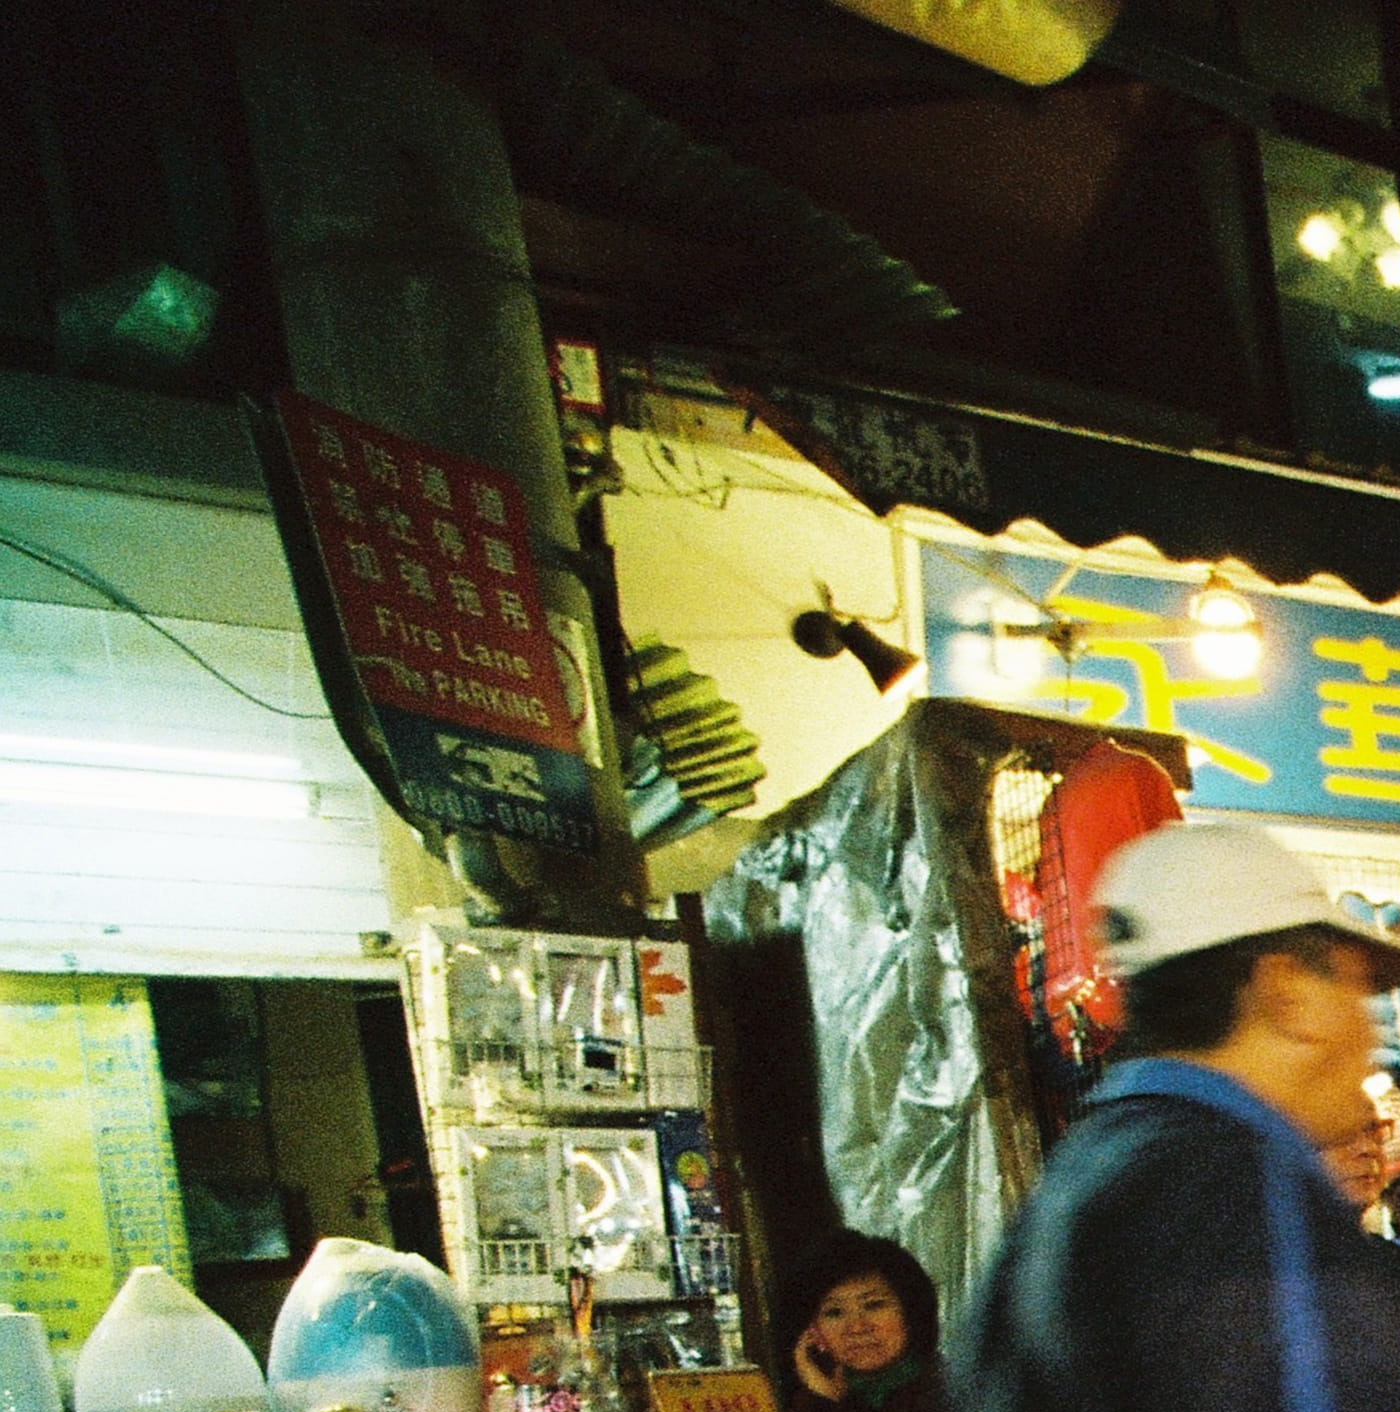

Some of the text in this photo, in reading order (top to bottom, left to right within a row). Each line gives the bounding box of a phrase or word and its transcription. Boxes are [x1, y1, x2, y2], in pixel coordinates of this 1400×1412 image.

[376, 605, 532, 681] Fire Lane
[433, 669, 552, 728] PARKING
